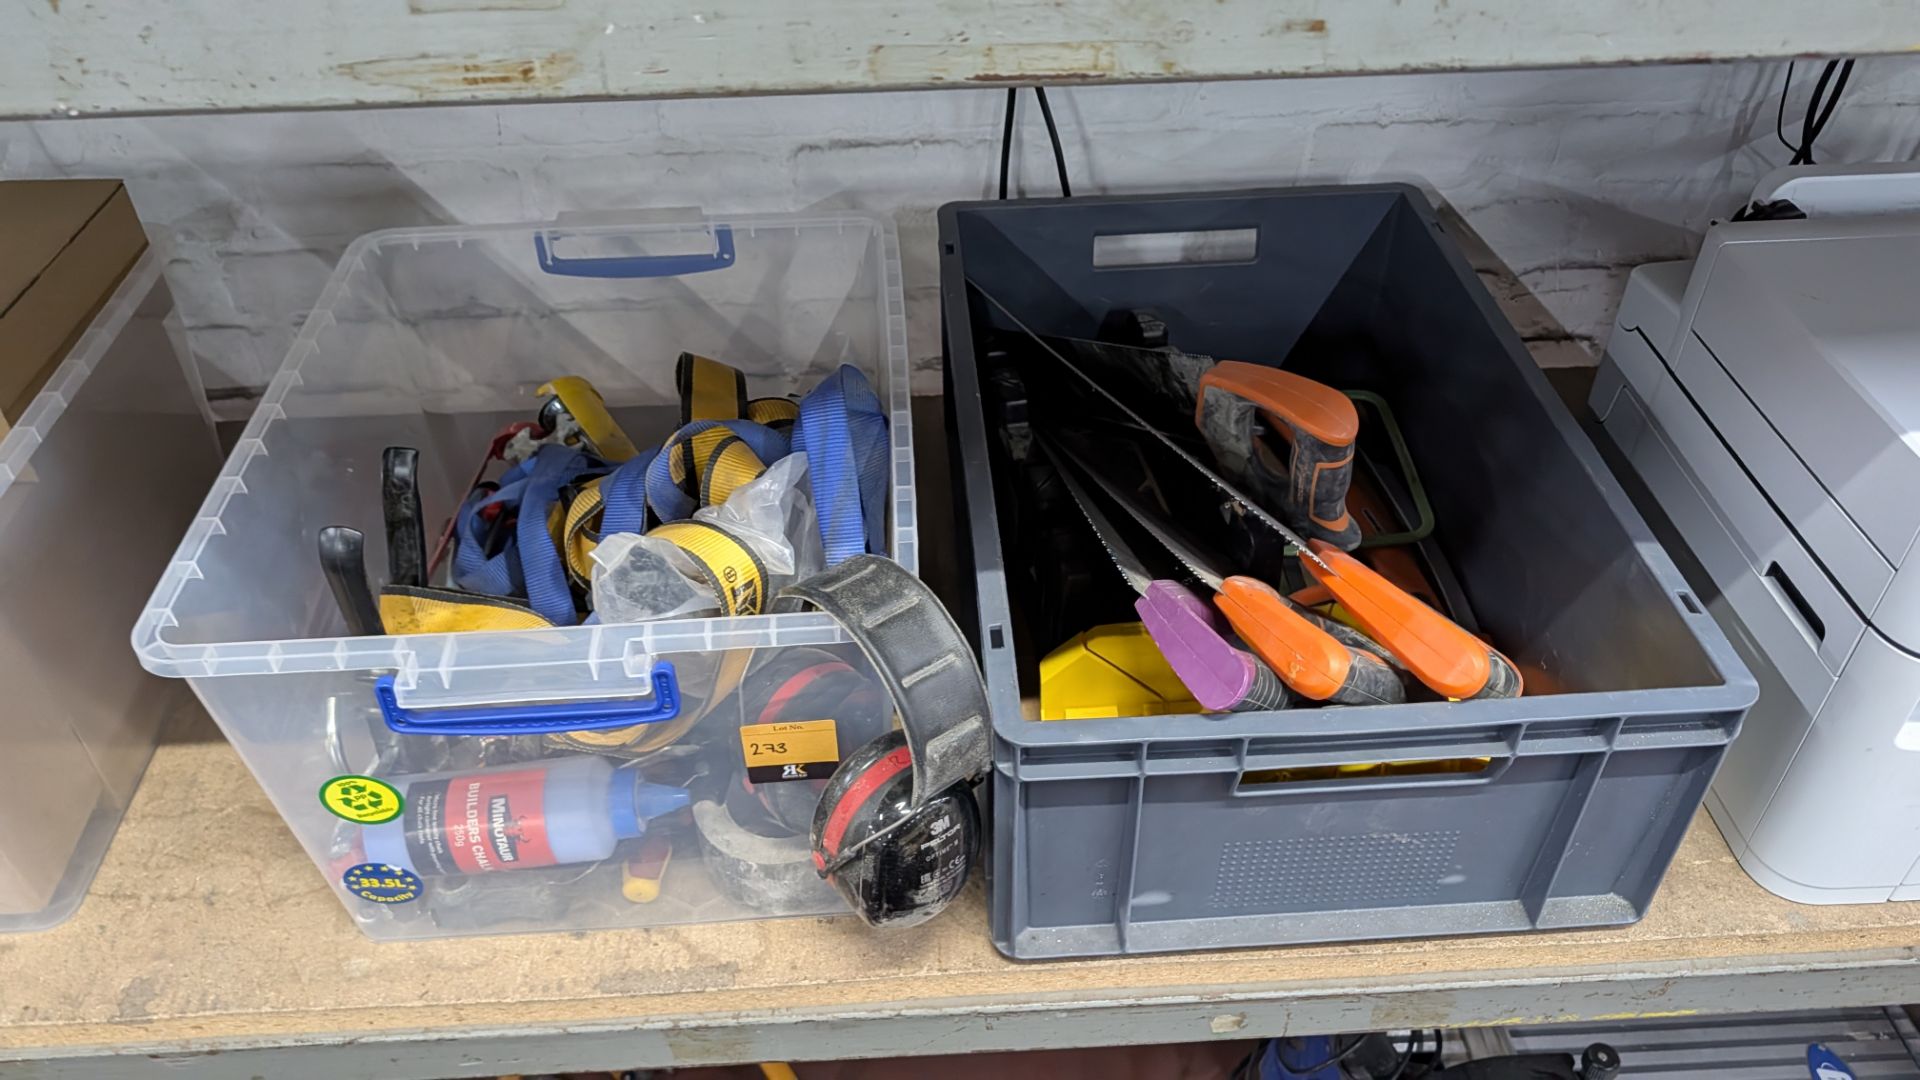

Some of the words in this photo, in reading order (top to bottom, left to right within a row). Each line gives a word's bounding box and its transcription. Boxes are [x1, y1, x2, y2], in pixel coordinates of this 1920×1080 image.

[750, 743, 788, 755] 273
[466, 782, 481, 844] BUILDERS
[930, 815, 950, 835] 3M
[453, 824, 466, 848] 250g
[359, 878, 407, 888] 33.5L
[361, 890, 415, 902] Capacity
